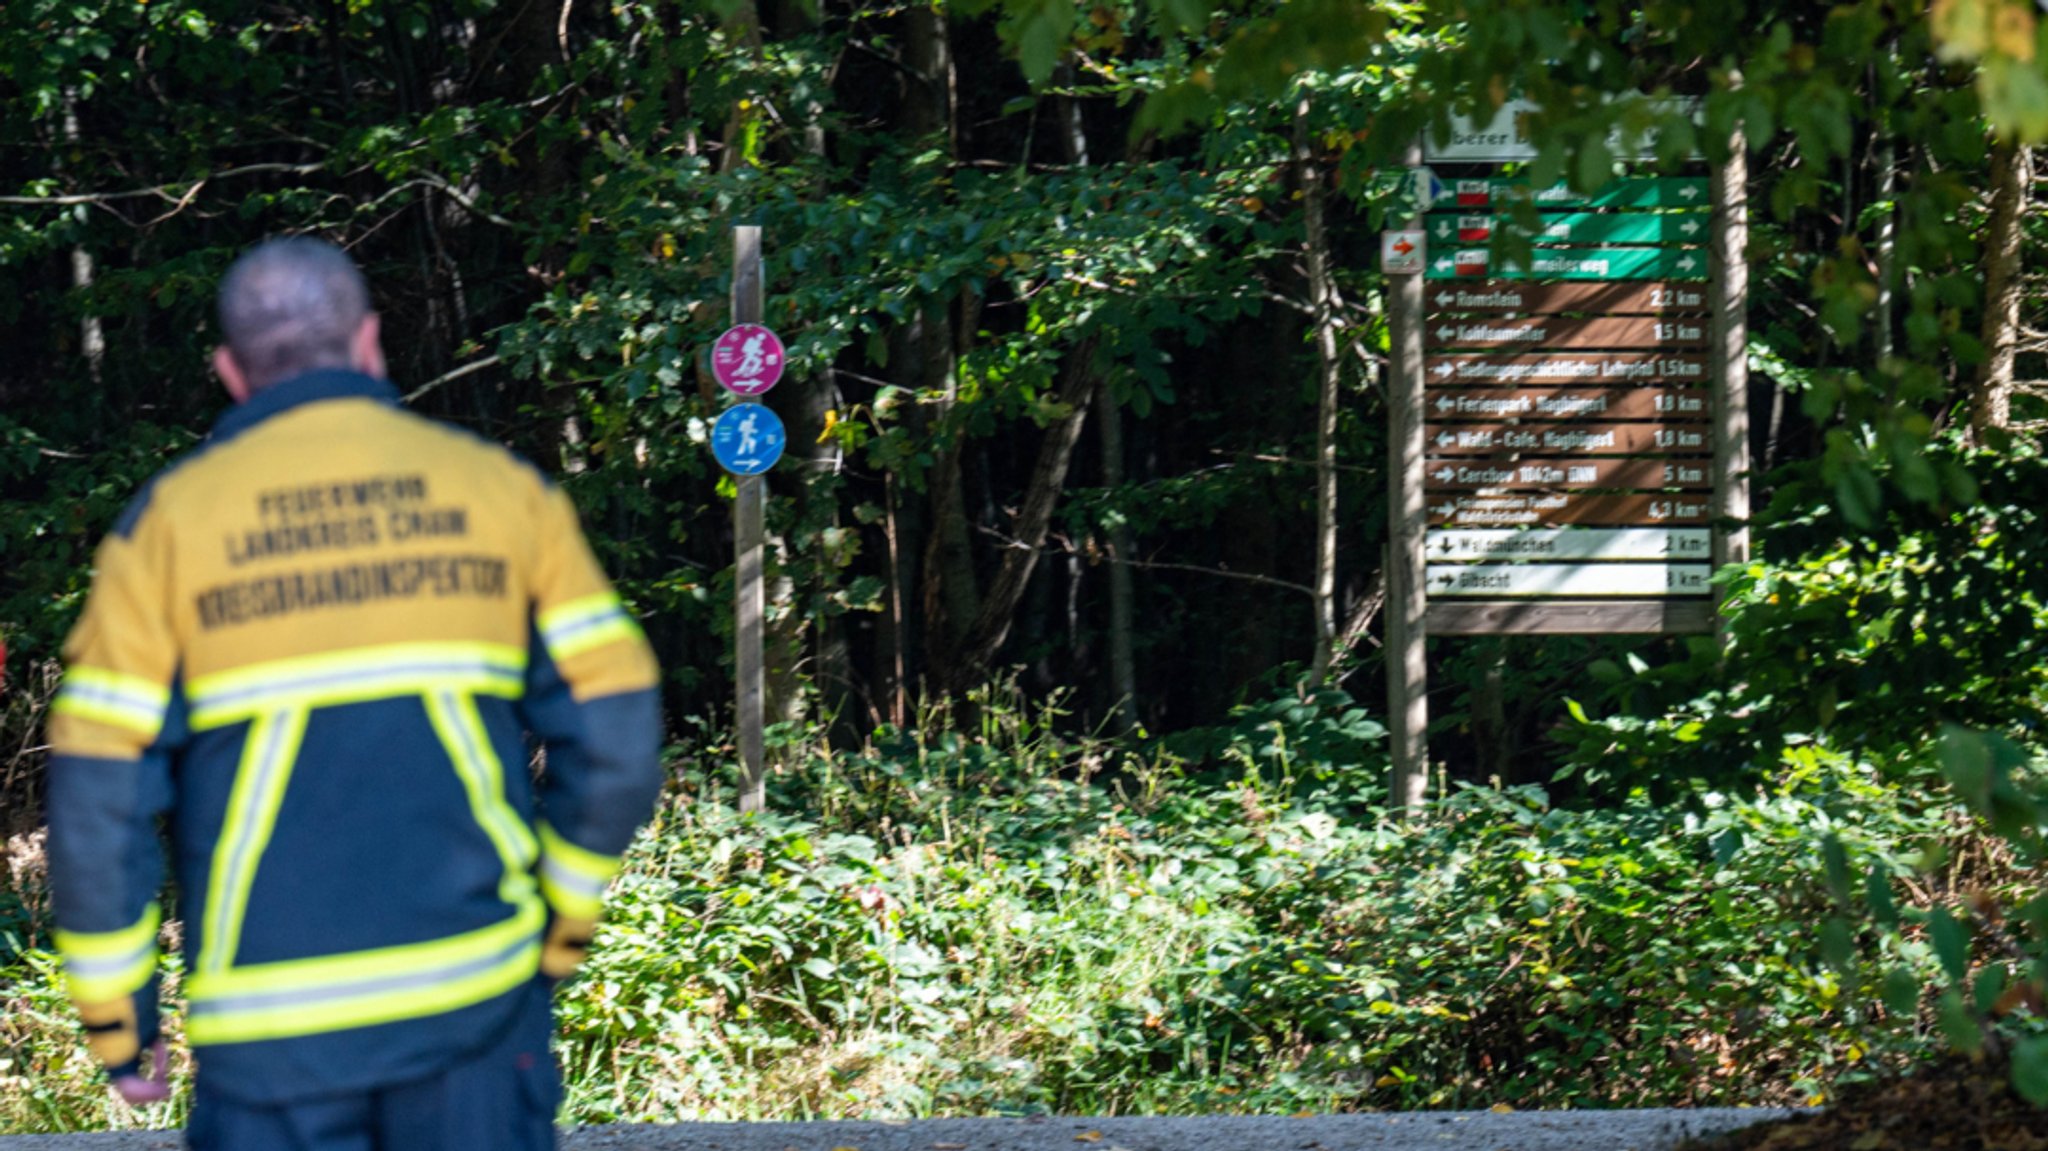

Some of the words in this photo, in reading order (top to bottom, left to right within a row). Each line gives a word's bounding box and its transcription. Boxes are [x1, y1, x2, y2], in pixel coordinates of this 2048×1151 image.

[1456, 289, 1522, 306] Ramstein
[1676, 289, 1700, 306] km
[1677, 323, 1700, 340] km
[1456, 395, 1531, 416] Ferienpark
[1677, 394, 1701, 411] km
[1677, 430, 1701, 447] km
[1664, 465, 1674, 482] 5
[1677, 465, 1701, 482] km
[258, 474, 426, 515] FEUERWEHR
[1674, 501, 1699, 517] km
[226, 515, 377, 566] LANDKREIS
[389, 507, 467, 542] CHAM
[1459, 536, 1554, 552] Waldmünchen
[1678, 536, 1701, 551] km
[1679, 571, 1701, 587] km
[196, 554, 506, 631] KREISBRANDINSPEKTOR
